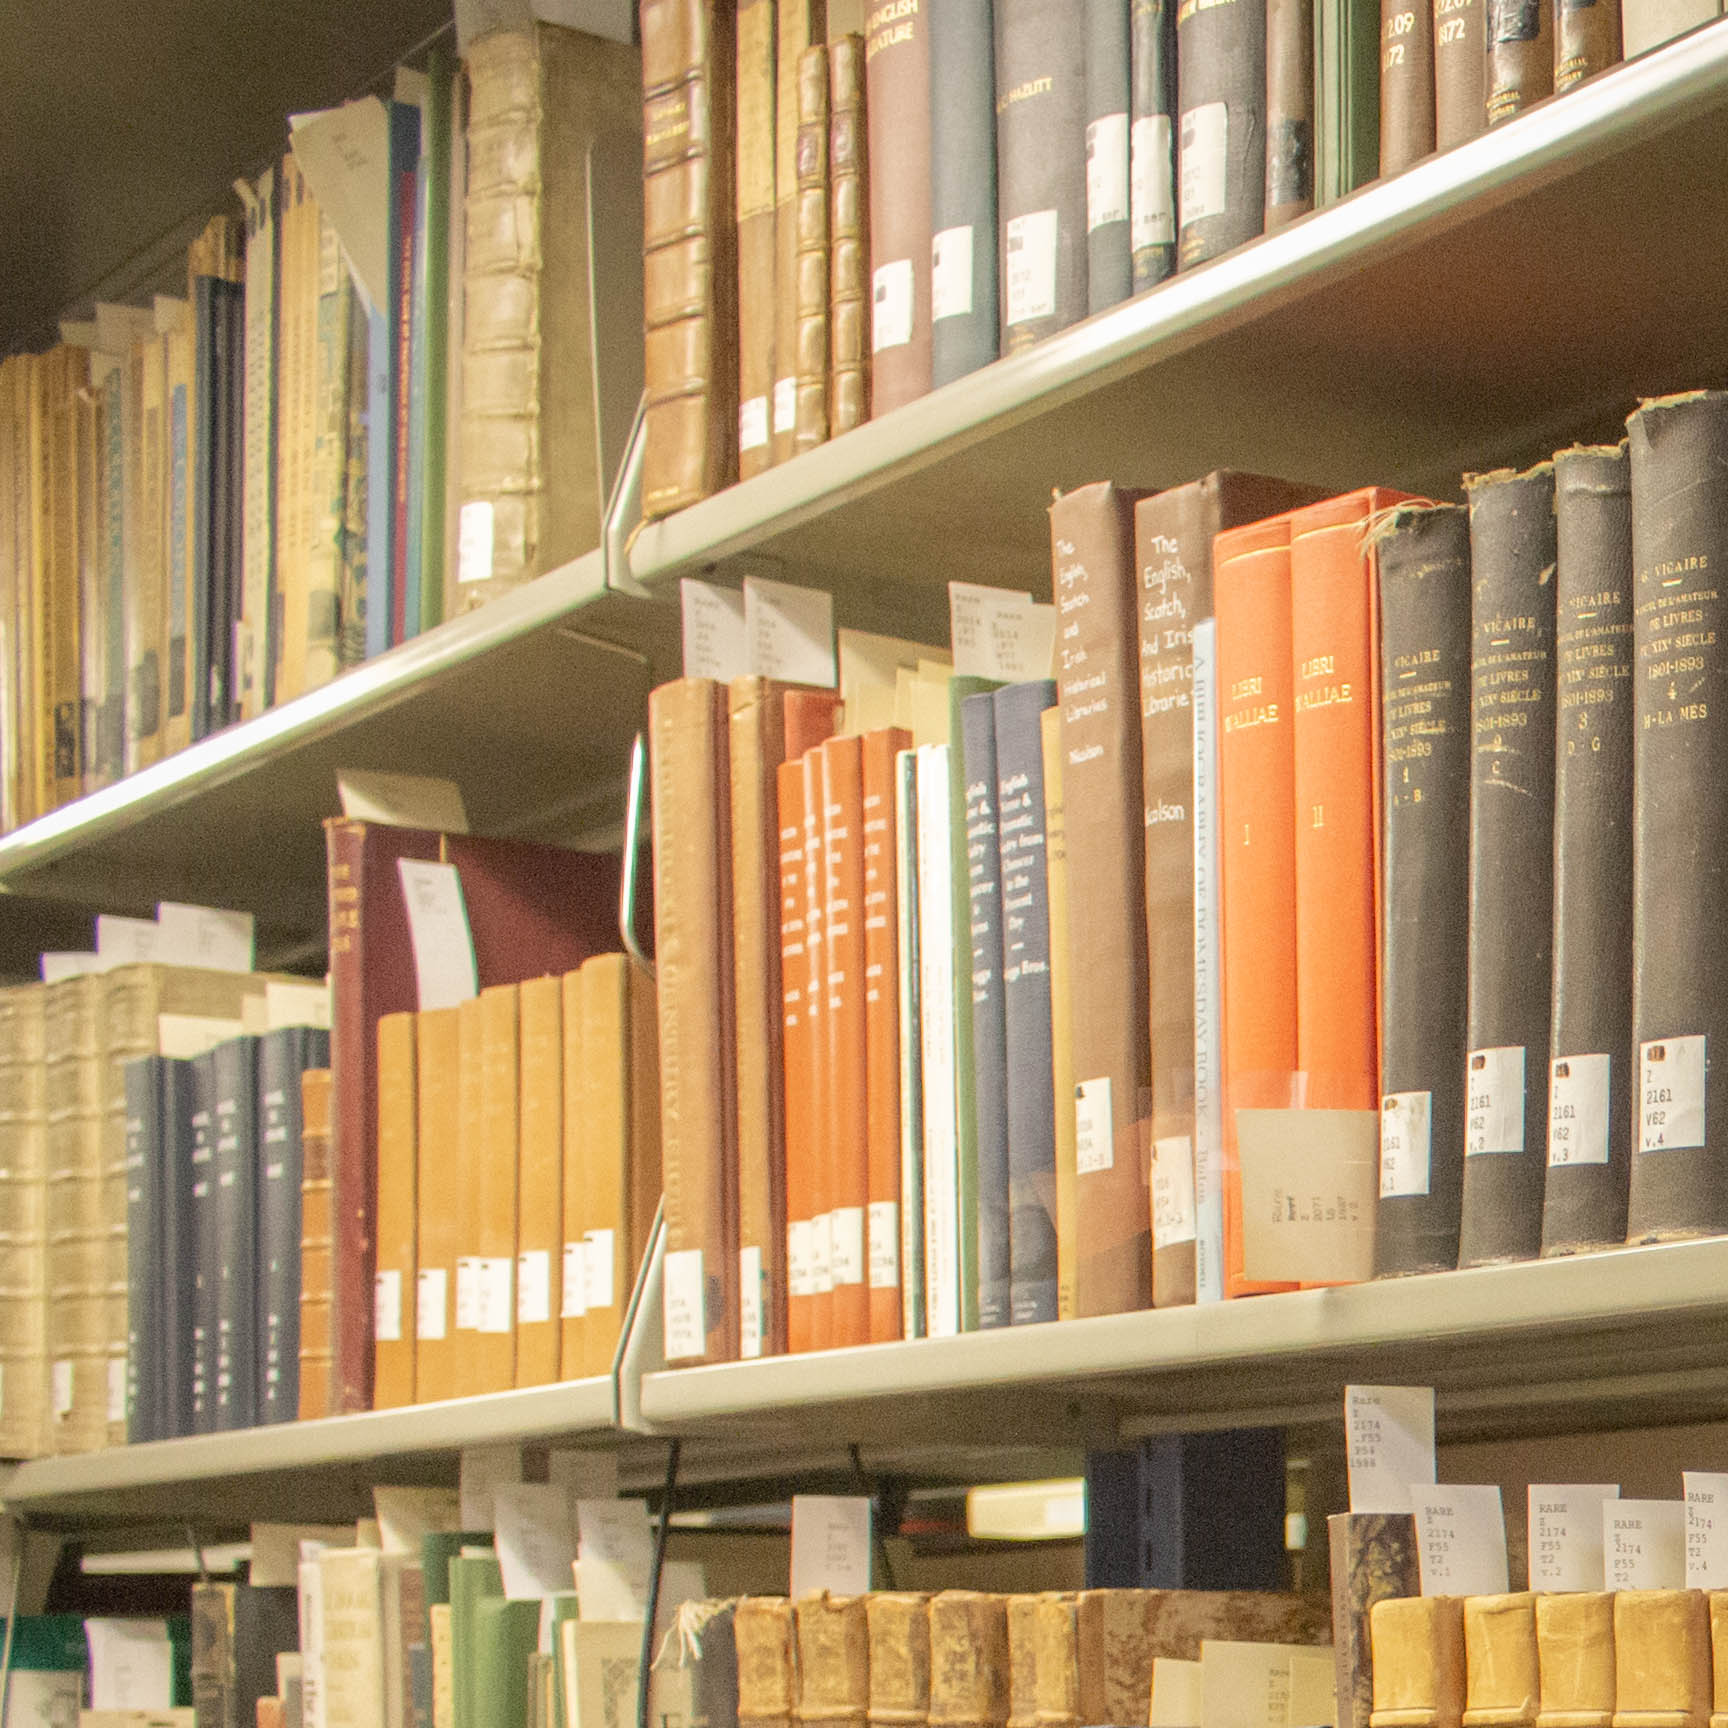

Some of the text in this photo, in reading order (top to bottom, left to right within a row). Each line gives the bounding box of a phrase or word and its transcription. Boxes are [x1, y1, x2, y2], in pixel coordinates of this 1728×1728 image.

[1151, 535, 1179, 554] The
[1654, 555, 1709, 578] VICAIRE
[1143, 556, 1192, 595] English,
[1143, 591, 1186, 622] Scotch,
[1568, 591, 1621, 609] VICAIRE
[1483, 617, 1536, 633] VICAIRE
[1663, 609, 1704, 626] LIVRES
[1163, 624, 1194, 650] Iris
[1301, 655, 1335, 680] LIBRI
[1231, 676, 1263, 701] LIBRI
[1578, 712, 1587, 729] 3
[1646, 1089, 1672, 1105] 2161
[1646, 1111, 1665, 1127] V62
[1645, 1132, 1664, 1148] v.4
[1688, 1492, 1715, 1504] RARE
[1539, 1504, 1567, 1514] RARE
[1614, 1519, 1642, 1530] RARE
[1688, 1516, 1713, 1529] 2174
[1539, 1527, 1566, 1538] 2174
[1688, 1533, 1708, 1544] F55
[1615, 1543, 1642, 1555] 2174
[1688, 1547, 1702, 1557] T2
